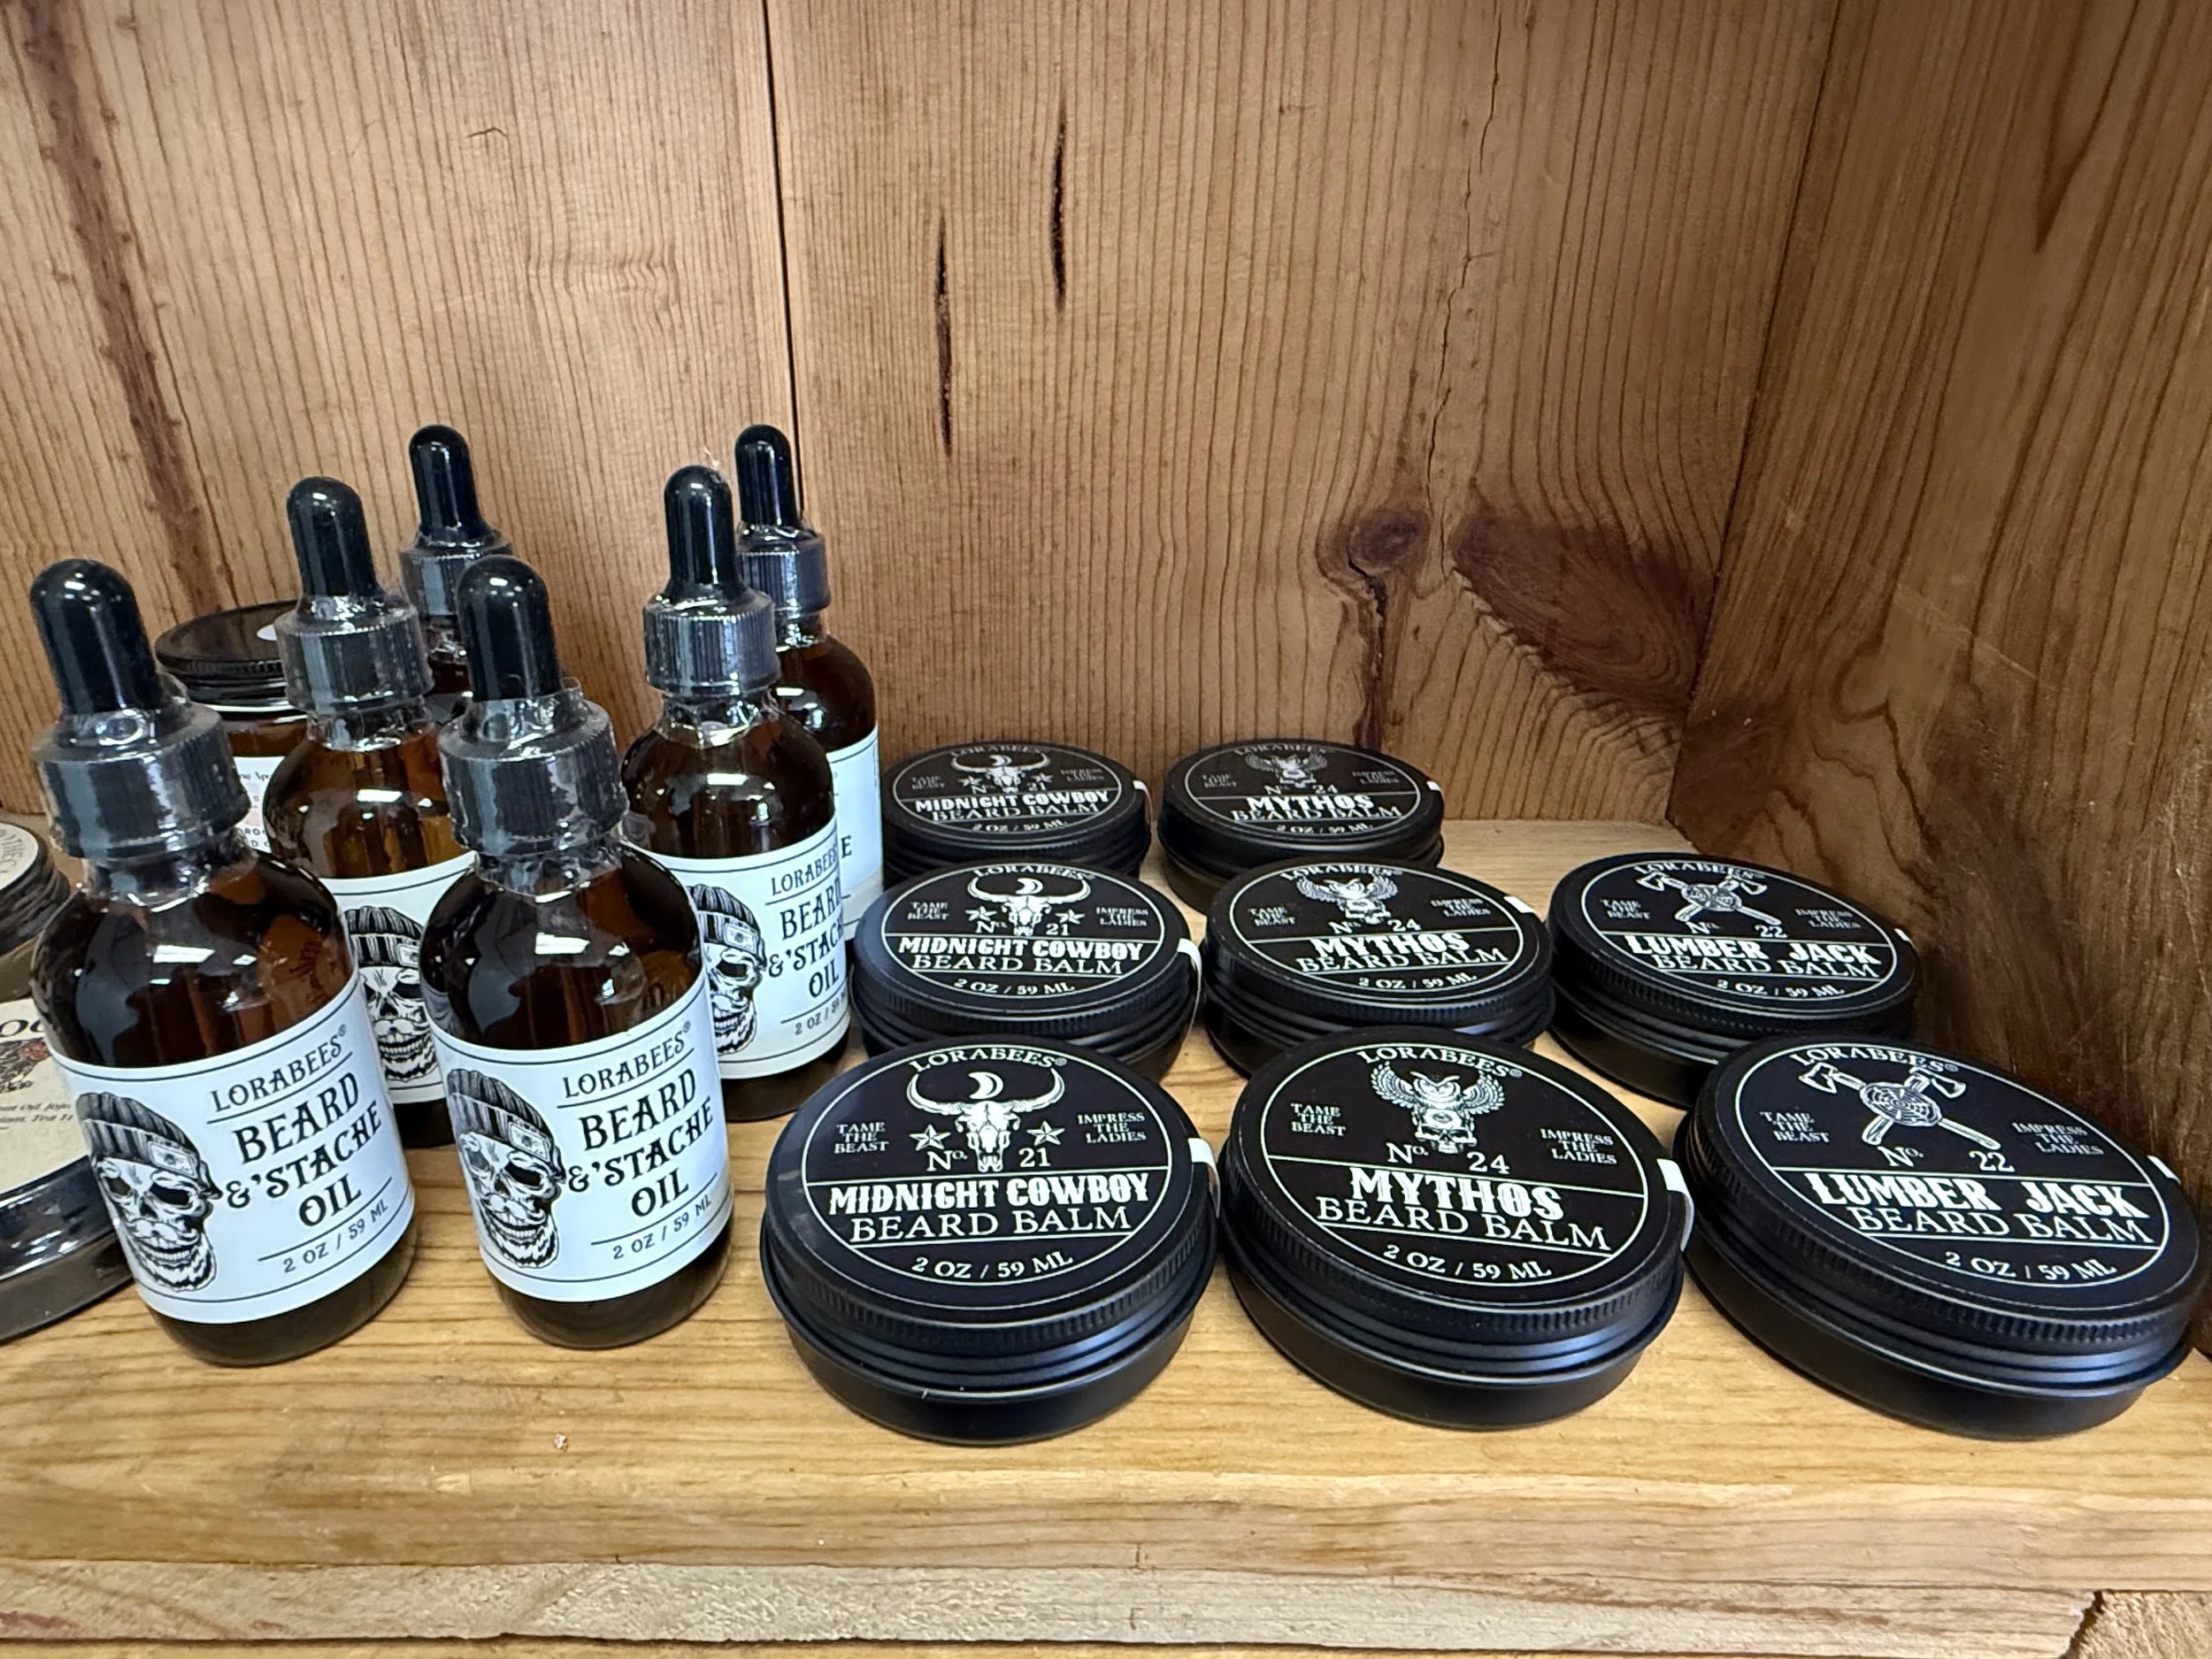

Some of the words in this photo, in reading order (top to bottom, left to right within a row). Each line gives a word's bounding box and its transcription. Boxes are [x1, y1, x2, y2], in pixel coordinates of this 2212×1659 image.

[1312, 784, 1339, 795] 24
[915, 795, 1018, 812] MIDNIGHT
[1022, 790, 1109, 806] COWBOY
[1246, 795, 1375, 812] MYTHOS
[932, 807, 1020, 821] BEARD
[1029, 803, 1099, 816] BALM
[1231, 809, 1323, 822] BEARD
[1330, 806, 1402, 819] BALM
[1046, 924, 1069, 935] 21
[1387, 918, 1422, 932] 24
[1755, 924, 1787, 938] 22
[898, 936, 1028, 956] MIDNIGHT
[1032, 941, 1144, 961] COWBOY
[1310, 933, 1471, 957] MYTHOS
[1624, 935, 1769, 960] LUMBER
[1789, 942, 1882, 964] JACK
[911, 955, 1023, 971] BEARD
[1035, 958, 1122, 974] BALM
[1296, 954, 1409, 972] BEARD
[1418, 949, 1509, 966] BALM
[1651, 954, 1771, 972] BEARD
[1779, 959, 1879, 979] BALM
[809, 959, 839, 998] OIL
[954, 979, 966, 988] 2
[971, 982, 999, 993] OZ
[1017, 984, 1039, 995] 59
[1044, 982, 1075, 995] ML
[1359, 978, 1370, 987] 2
[1376, 979, 1407, 989] OZ
[1424, 978, 1444, 989] 59
[1448, 972, 1478, 985] ML
[1717, 979, 1727, 988] 2
[1736, 983, 1768, 995] OZ
[1786, 986, 1809, 997] 59
[1812, 983, 1845, 995] ML
[795, 1023, 803, 1035] 2
[807, 1012, 821, 1029] OZ
[232, 1071, 359, 1164] BEARD
[579, 1068, 696, 1151] BEARD
[1078, 1112, 1145, 1125] IMPRESS
[1291, 1102, 1341, 1118] TAME
[1300, 1113, 1334, 1125] THE
[1759, 1110, 1815, 1125] TAME
[837, 1122, 885, 1133] TAME
[843, 1131, 877, 1141] THE
[1093, 1122, 1129, 1133] THE
[1291, 1121, 1346, 1136] BEAST
[1771, 1120, 1813, 1133] THE
[2012, 1122, 2088, 1136] IMPRESS
[1086, 1131, 1146, 1143] LADIES
[1540, 1128, 1615, 1147] IMPRESS
[1559, 1139, 1598, 1153] THE
[1773, 1130, 1831, 1143] BEAST
[2036, 1132, 2078, 1146] THE
[834, 1141, 888, 1154] BEAST
[1551, 1148, 1617, 1165] LADIES
[2035, 1141, 2105, 1156] LADIES
[1019, 1148, 1051, 1168] 21
[1467, 1152, 1509, 1174] 24
[1970, 1149, 2015, 1172] 22
[299, 1173, 361, 1226] OIL
[632, 1167, 689, 1217] OIL
[829, 1180, 999, 1215] MIDNIGHT
[1007, 1172, 1149, 1207] COWBOY
[1349, 1166, 1564, 1221] MYTHOS
[1804, 1171, 2002, 1211] LUMBER
[2024, 1179, 2151, 1219] JACK
[612, 1245, 624, 1260] 2
[632, 1233, 655, 1253] OZ
[662, 1225, 667, 1241] /
[674, 1211, 689, 1232] 59
[695, 1194, 711, 1217] ML
[849, 1213, 999, 1243] BEARD
[1014, 1206, 1132, 1234] BALM
[1316, 1197, 1469, 1233] BEARD
[1485, 1216, 1611, 1251] BALM
[1846, 1205, 2010, 1236] BEARD
[2015, 1212, 2154, 1243] BALM
[283, 1258, 296, 1273] 2
[303, 1242, 329, 1263] OZ
[335, 1233, 342, 1249] /
[349, 1218, 365, 1240] 59
[371, 1199, 388, 1224] ML
[912, 1257, 926, 1272] 2
[934, 1261, 972, 1279] OZ
[979, 1263, 988, 1279] /
[997, 1261, 1025, 1278] 59
[1033, 1250, 1073, 1273] ML
[1383, 1244, 1399, 1260] 2
[1408, 1252, 1446, 1274] OZ
[1455, 1261, 1463, 1277] /
[1473, 1262, 1501, 1279] 59
[1508, 1260, 1551, 1280] ML
[1946, 1251, 1961, 1267] 2
[1970, 1258, 2017, 1278] OZ
[2025, 1263, 2032, 1280] /
[2038, 1263, 2070, 1282] 59
[2076, 1258, 2118, 1278] ML
